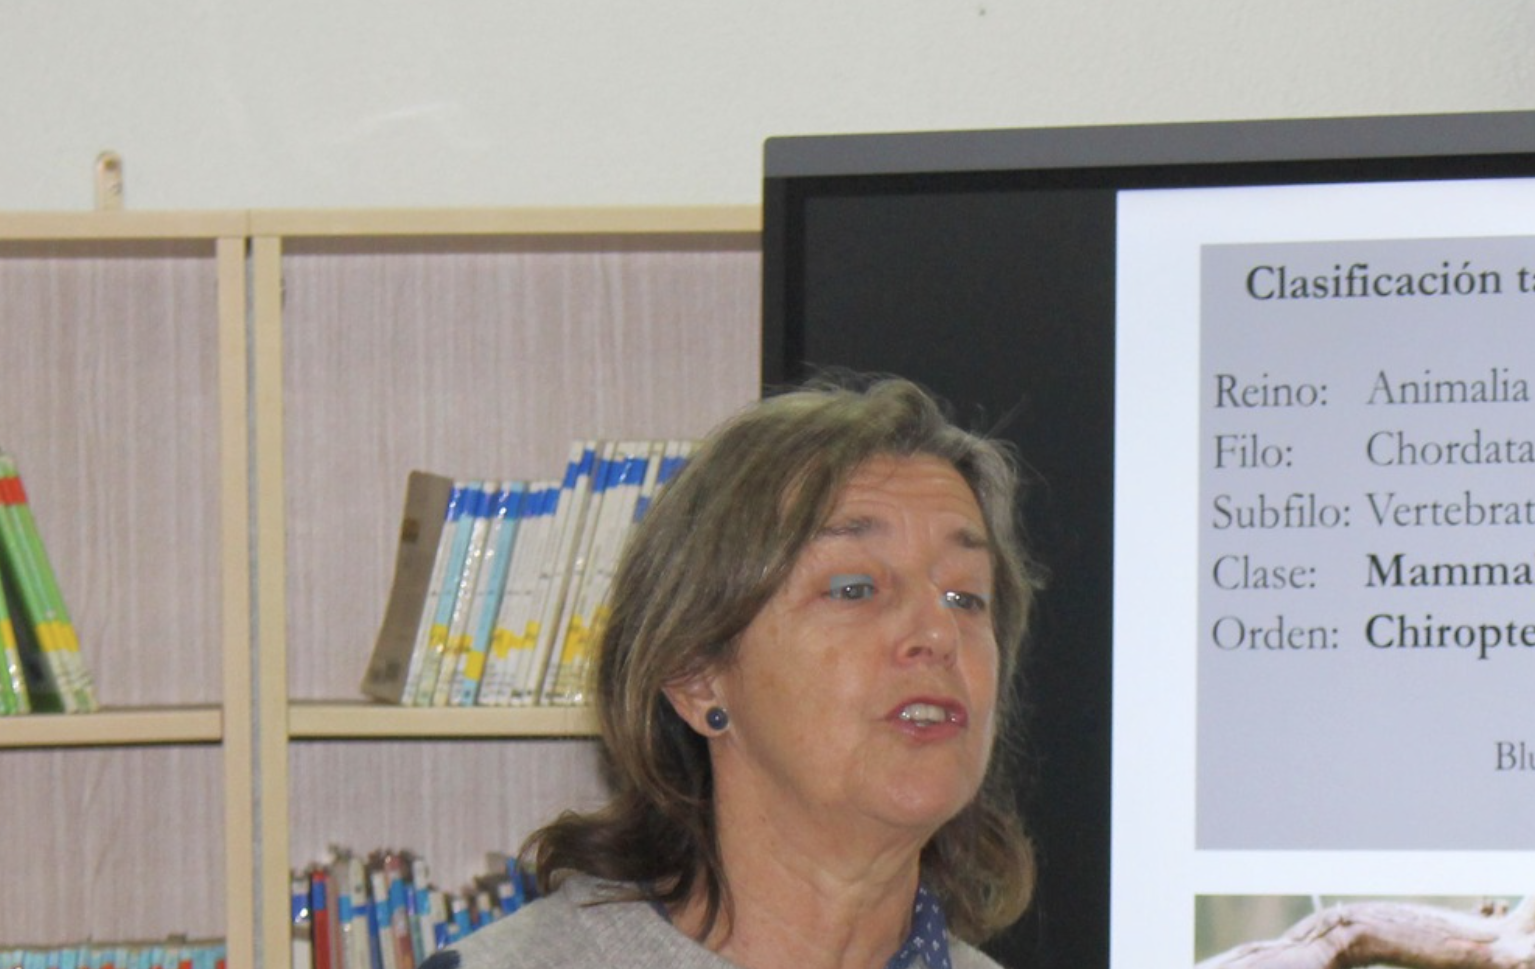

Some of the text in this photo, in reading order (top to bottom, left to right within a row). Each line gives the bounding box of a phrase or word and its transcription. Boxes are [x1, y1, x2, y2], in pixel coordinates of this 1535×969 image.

[1245, 261, 1502, 301] Clasificación
[1215, 368, 1530, 409] Reino: Animalia
[1214, 429, 1535, 469] Filo: Chordata
[1212, 493, 1351, 530] Subfilo:
[1212, 555, 1316, 590] Clase:
[1211, 615, 1339, 651] Orden:
